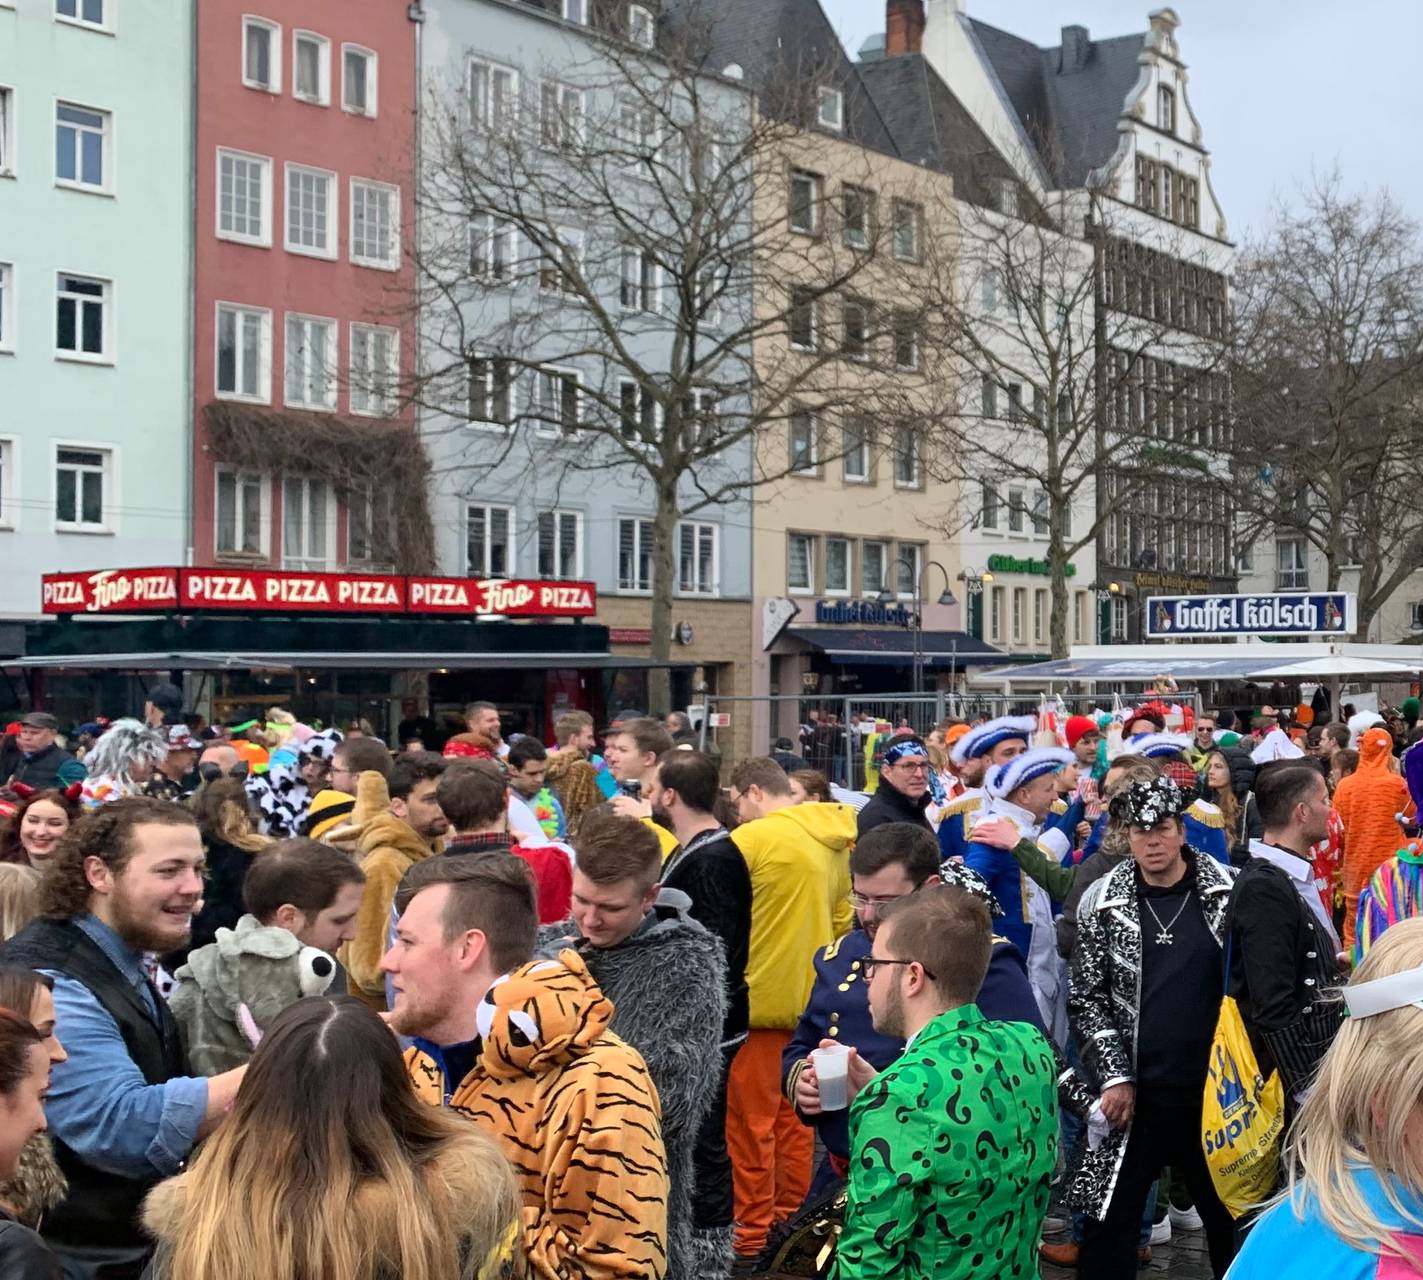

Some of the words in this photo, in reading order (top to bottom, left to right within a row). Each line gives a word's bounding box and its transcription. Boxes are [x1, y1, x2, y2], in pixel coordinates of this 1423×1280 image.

[44, 582, 84, 604] PIZZA
[86, 570, 132, 611] Fino
[133, 576, 177, 600] PIZZA
[188, 576, 257, 600] PIZZA
[265, 579, 330, 602] PIZZA
[338, 580, 399, 605] PIZZA
[411, 583, 469, 606] PIZZA
[475, 579, 534, 614] Fino
[540, 587, 593, 608] PIZZA
[1175, 598, 1240, 631] Gaffel
[1243, 597, 1318, 631] Kölsch
